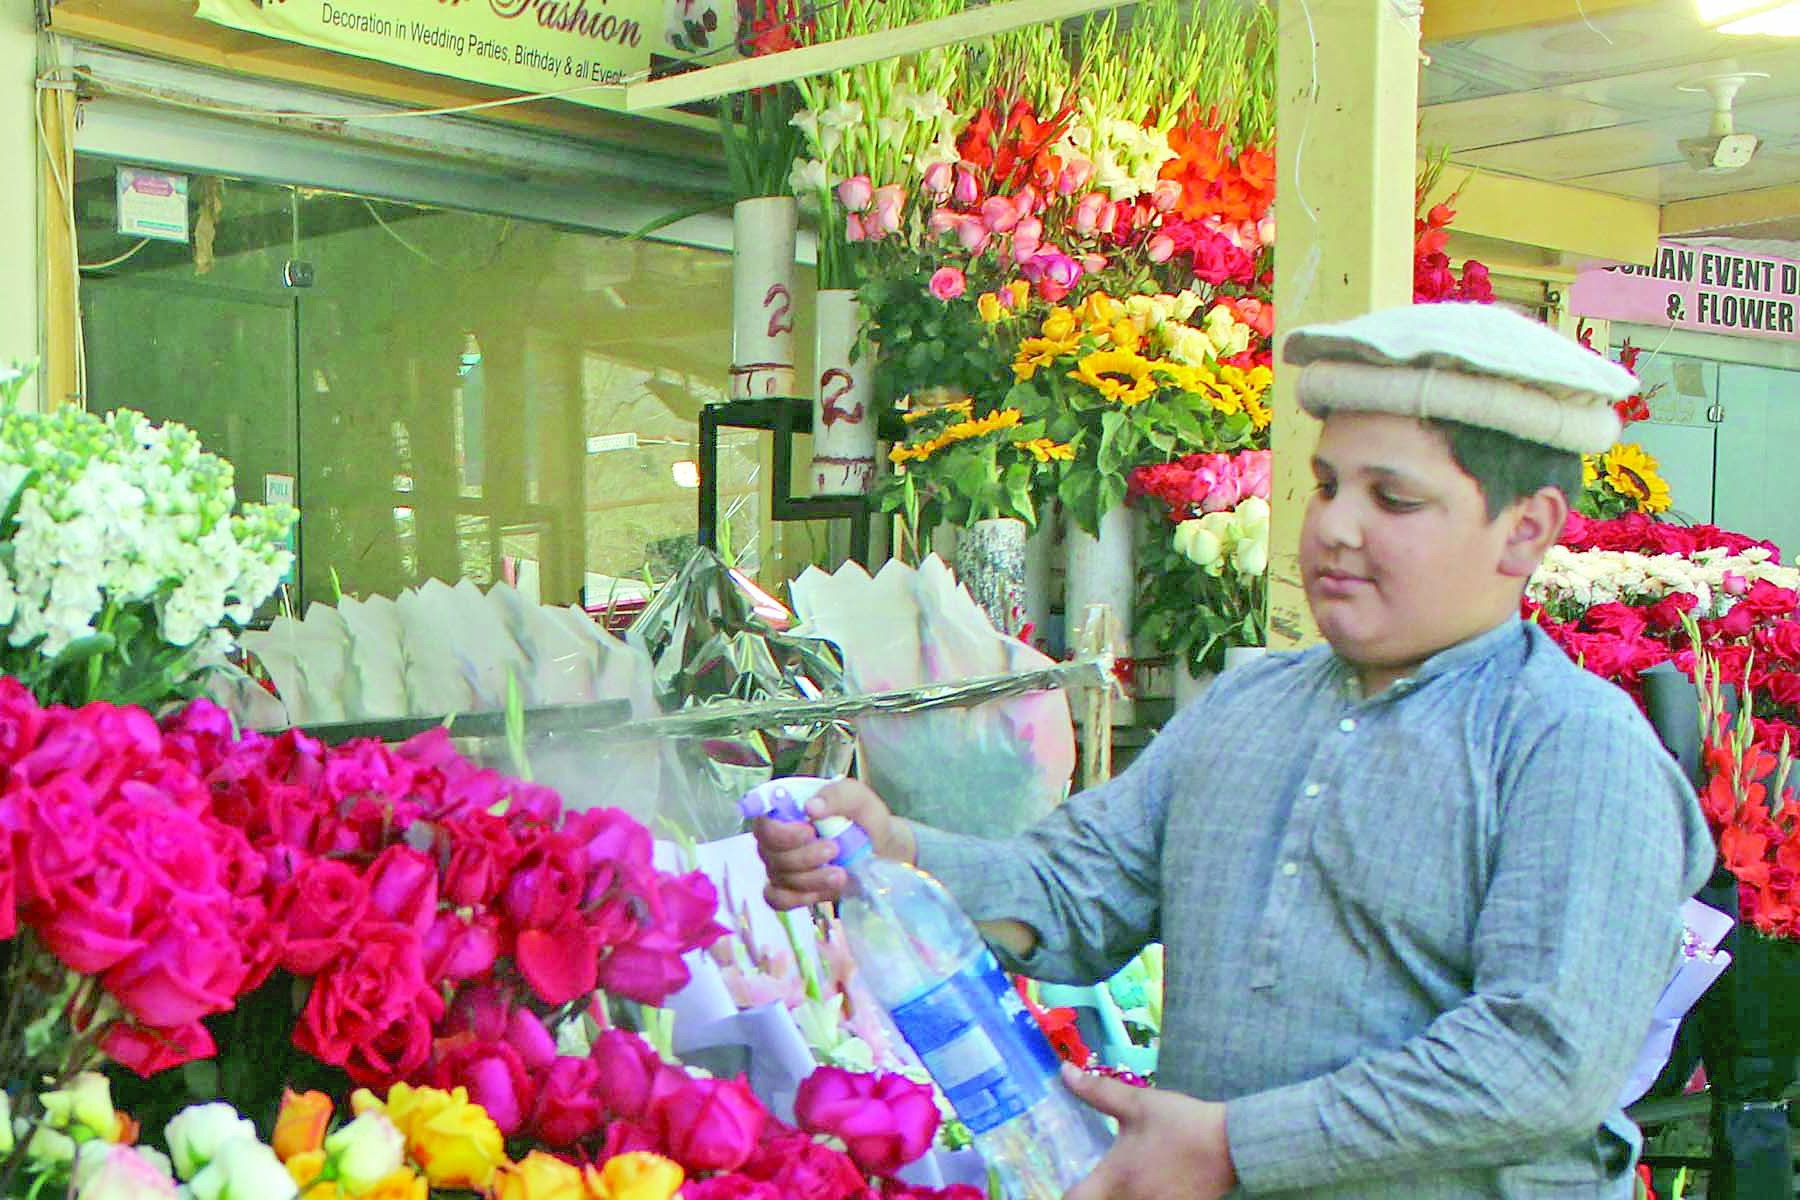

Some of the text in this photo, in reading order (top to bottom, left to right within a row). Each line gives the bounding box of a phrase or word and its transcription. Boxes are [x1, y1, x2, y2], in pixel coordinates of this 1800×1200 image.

[322, 2, 391, 37] Decoration
[395, 18, 407, 40] in
[410, 21, 464, 57] Wedding
[468, 34, 511, 65] Parties,
[515, 44, 561, 78] Birthday
[564, 56, 572, 76] &
[576, 60, 589, 80] all
[1701, 253, 1775, 292] EVENT
[763, 283, 792, 337] 2
[1666, 293, 1794, 332] & FLOWER
[820, 368, 865, 428] 2
